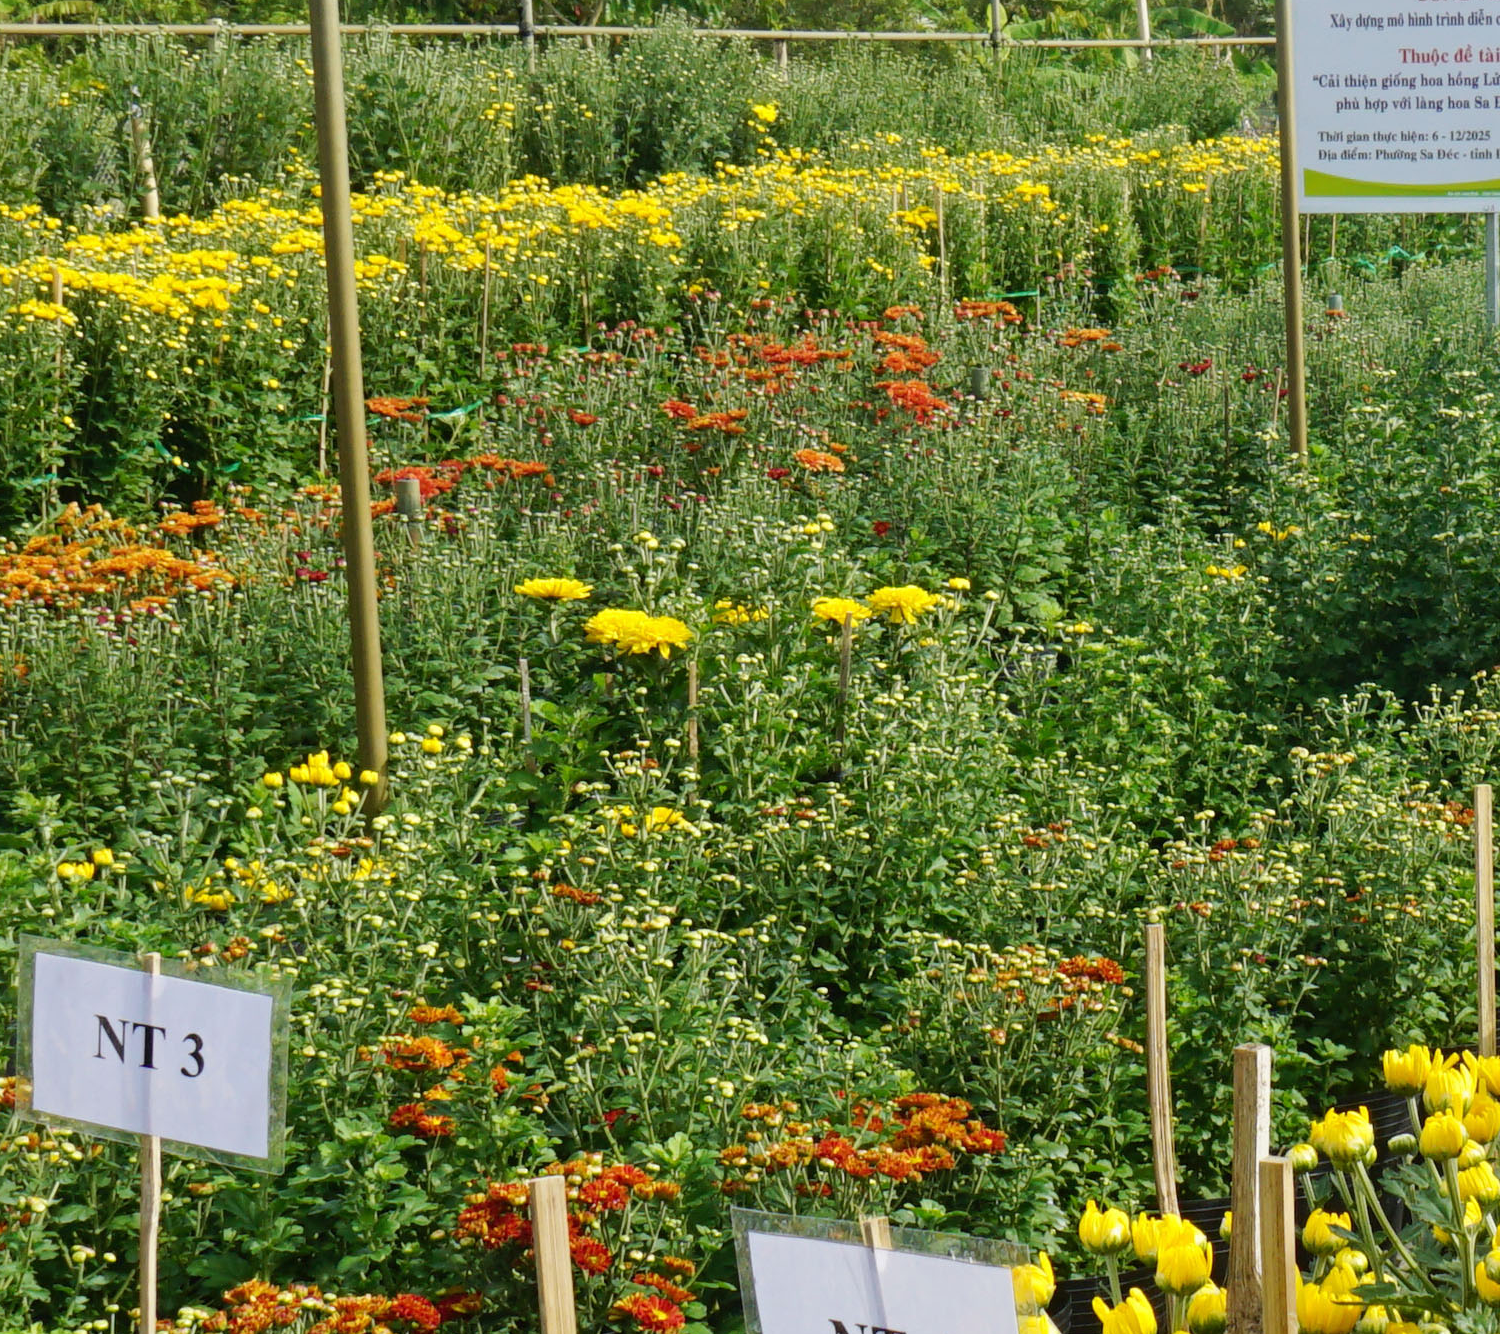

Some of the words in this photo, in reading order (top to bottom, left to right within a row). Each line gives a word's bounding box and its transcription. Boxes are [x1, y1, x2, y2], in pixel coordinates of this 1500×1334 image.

[1330, 13, 1351, 32] Xây
[1356, 14, 1384, 31] dựng
[1387, 13, 1404, 27] mô
[1408, 12, 1432, 27] hình
[1436, 11, 1464, 27] trình
[1467, 8, 1493, 26] diễn
[1399, 48, 1449, 66] Thuộc
[1454, 43, 1473, 63] đề
[1479, 47, 1500, 63] tài
[1345, 74, 1377, 90] thiện
[1381, 72, 1417, 90] giống
[1420, 72, 1443, 87] hoa
[1448, 70, 1479, 89] hồng
[1336, 96, 1360, 114] phù
[1365, 97, 1388, 113] hợp
[1392, 96, 1411, 110] với
[1416, 96, 1444, 112] làng
[1448, 95, 1470, 109] hoa
[1474, 95, 1490, 109] Sa
[1318, 130, 1343, 142] Thời
[1346, 131, 1370, 143] gian
[1373, 131, 1398, 143] thực
[1401, 131, 1428, 144] hiện:
[1432, 131, 1439, 141] 6
[1450, 130, 1491, 142] 12/2025
[1318, 149, 1337, 162] Địa
[1341, 147, 1372, 161] điểm:
[1376, 148, 1417, 162] Phường
[1420, 148, 1433, 160] Sa
[1437, 148, 1460, 160] Đéc
[1470, 148, 1492, 160] tỉnh
[92, 1013, 166, 1071] NT
[180, 1032, 205, 1078] 3
